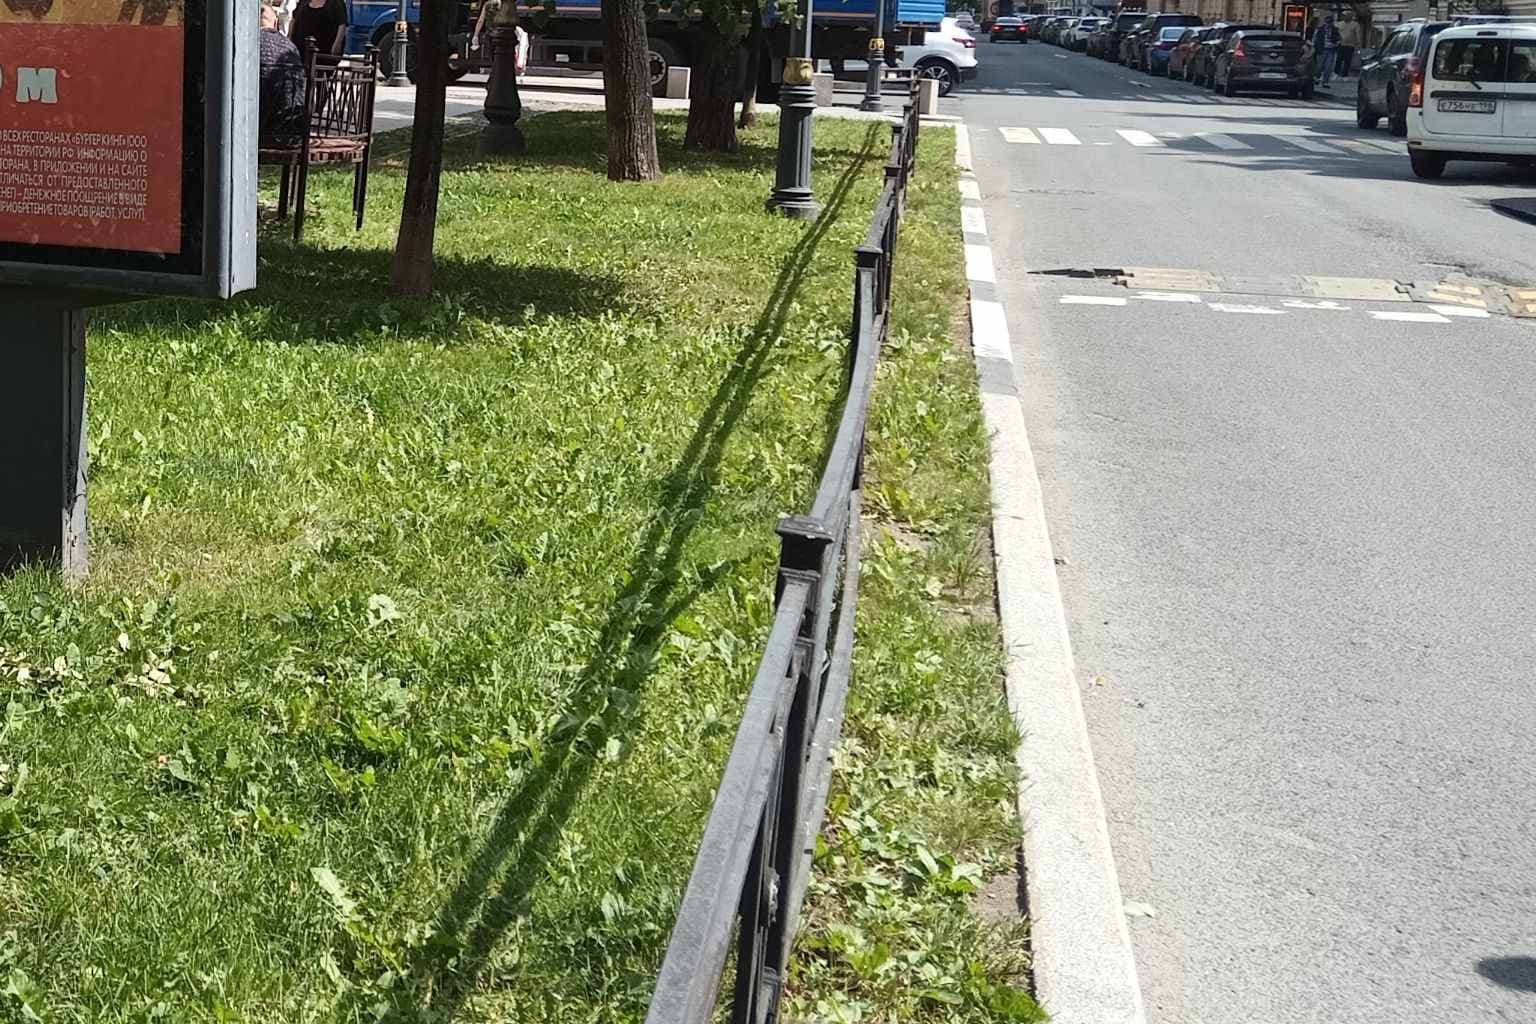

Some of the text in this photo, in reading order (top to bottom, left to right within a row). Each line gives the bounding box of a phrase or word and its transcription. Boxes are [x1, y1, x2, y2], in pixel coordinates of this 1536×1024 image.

[22, 130, 71, 145] РЕСТОРАНАХ
[13, 144, 60, 158] ТЕРРИТОРИИ
[77, 147, 138, 163] ИНФОРМАЦИЮ
[39, 159, 97, 174] ПРИЛОЖЕНИИ
[121, 164, 147, 177] САЙТЕ
[61, 175, 147, 192] ПРЕДОСТАВЛЕННОГО
